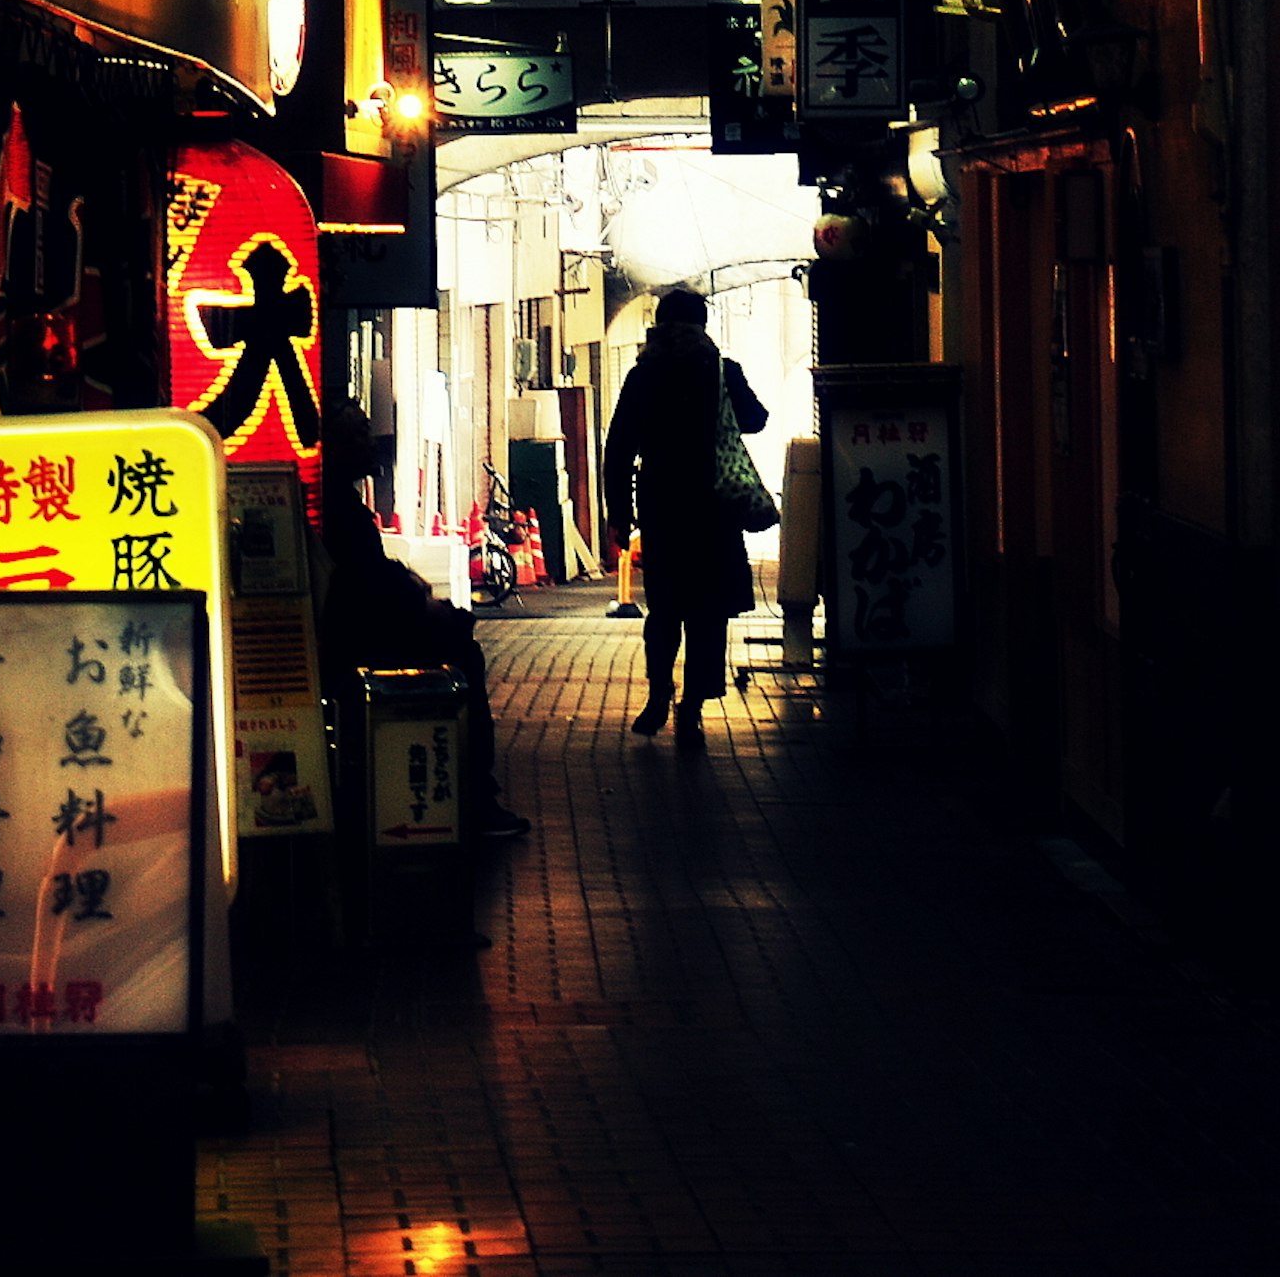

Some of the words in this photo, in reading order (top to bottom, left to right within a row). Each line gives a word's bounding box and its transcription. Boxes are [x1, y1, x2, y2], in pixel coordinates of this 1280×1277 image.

[108, 449, 182, 590] 焼豚
[50, 636, 119, 922] お魚料理
